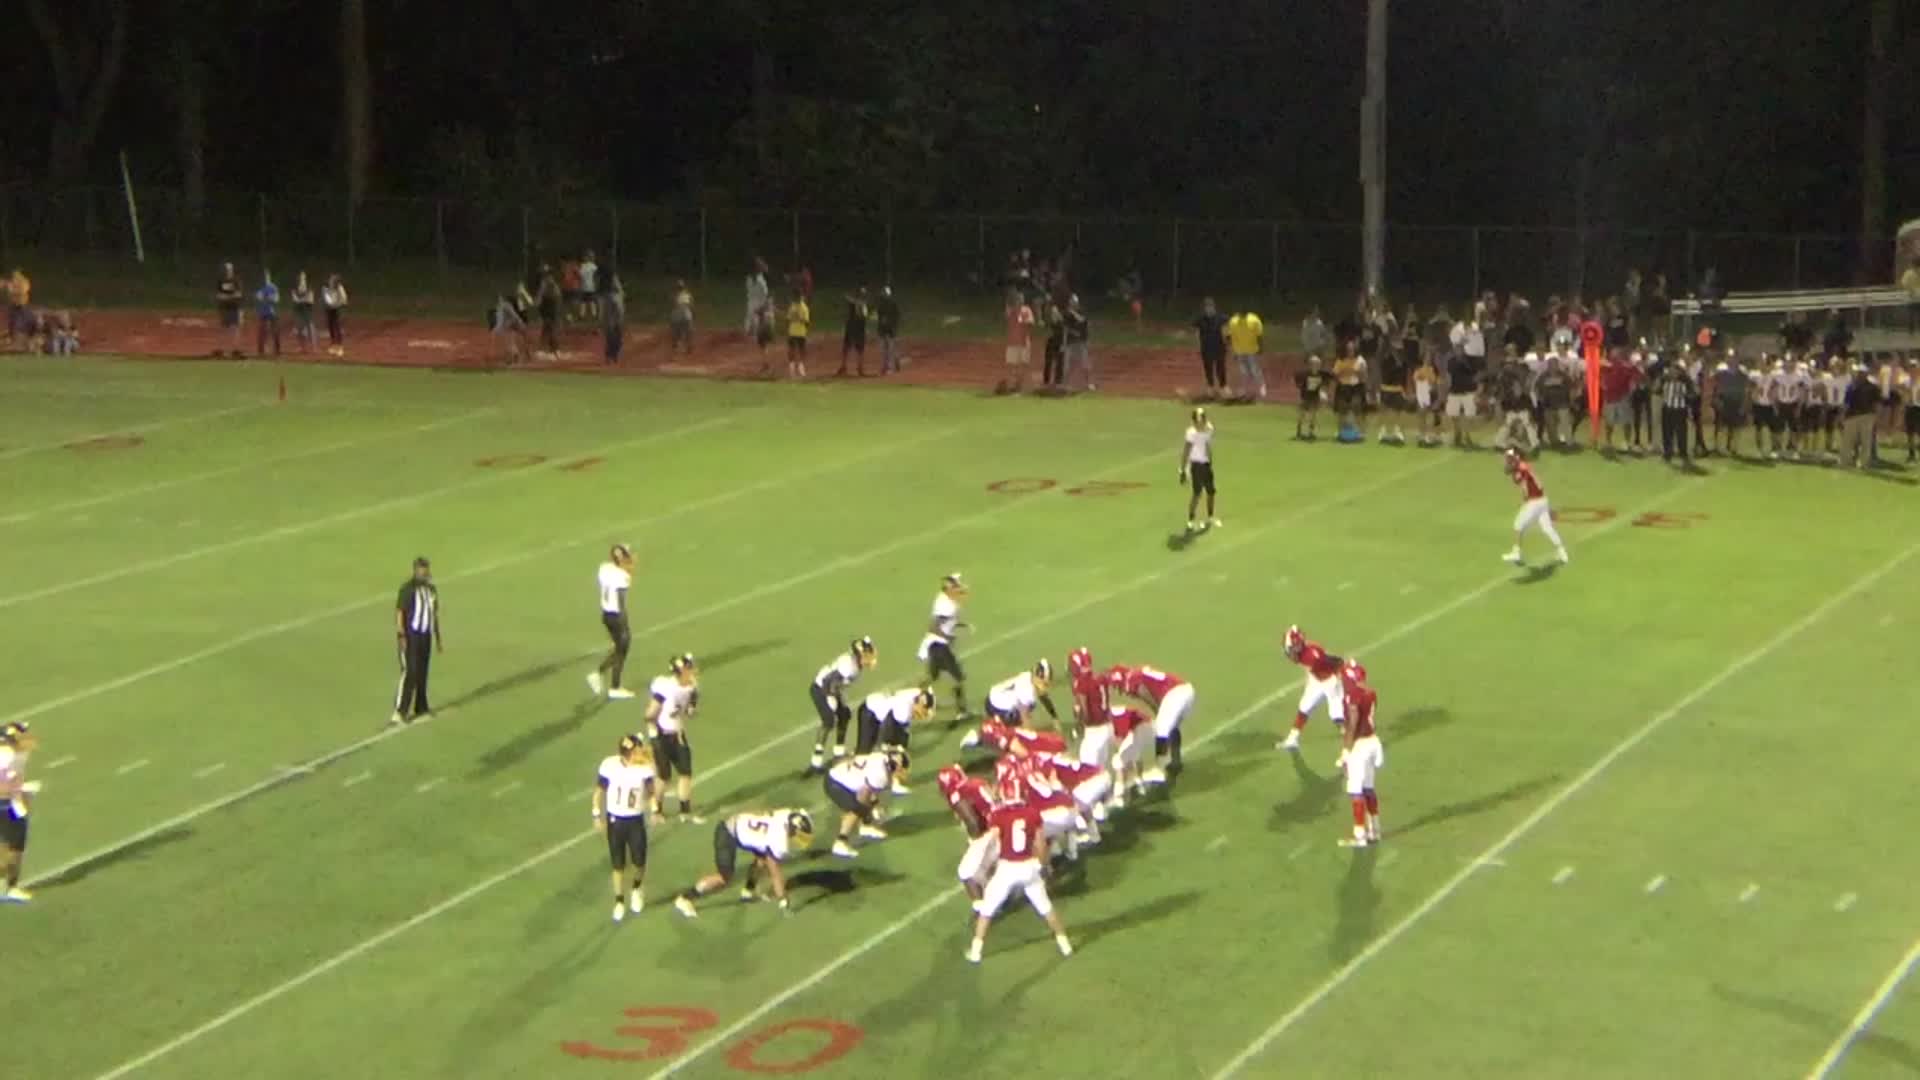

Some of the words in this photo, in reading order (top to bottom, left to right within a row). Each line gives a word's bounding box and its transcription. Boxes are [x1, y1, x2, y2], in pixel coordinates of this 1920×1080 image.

[616, 786, 641, 809] 16
[1012, 818, 1026, 852] 6
[560, 1004, 864, 1073] 30
